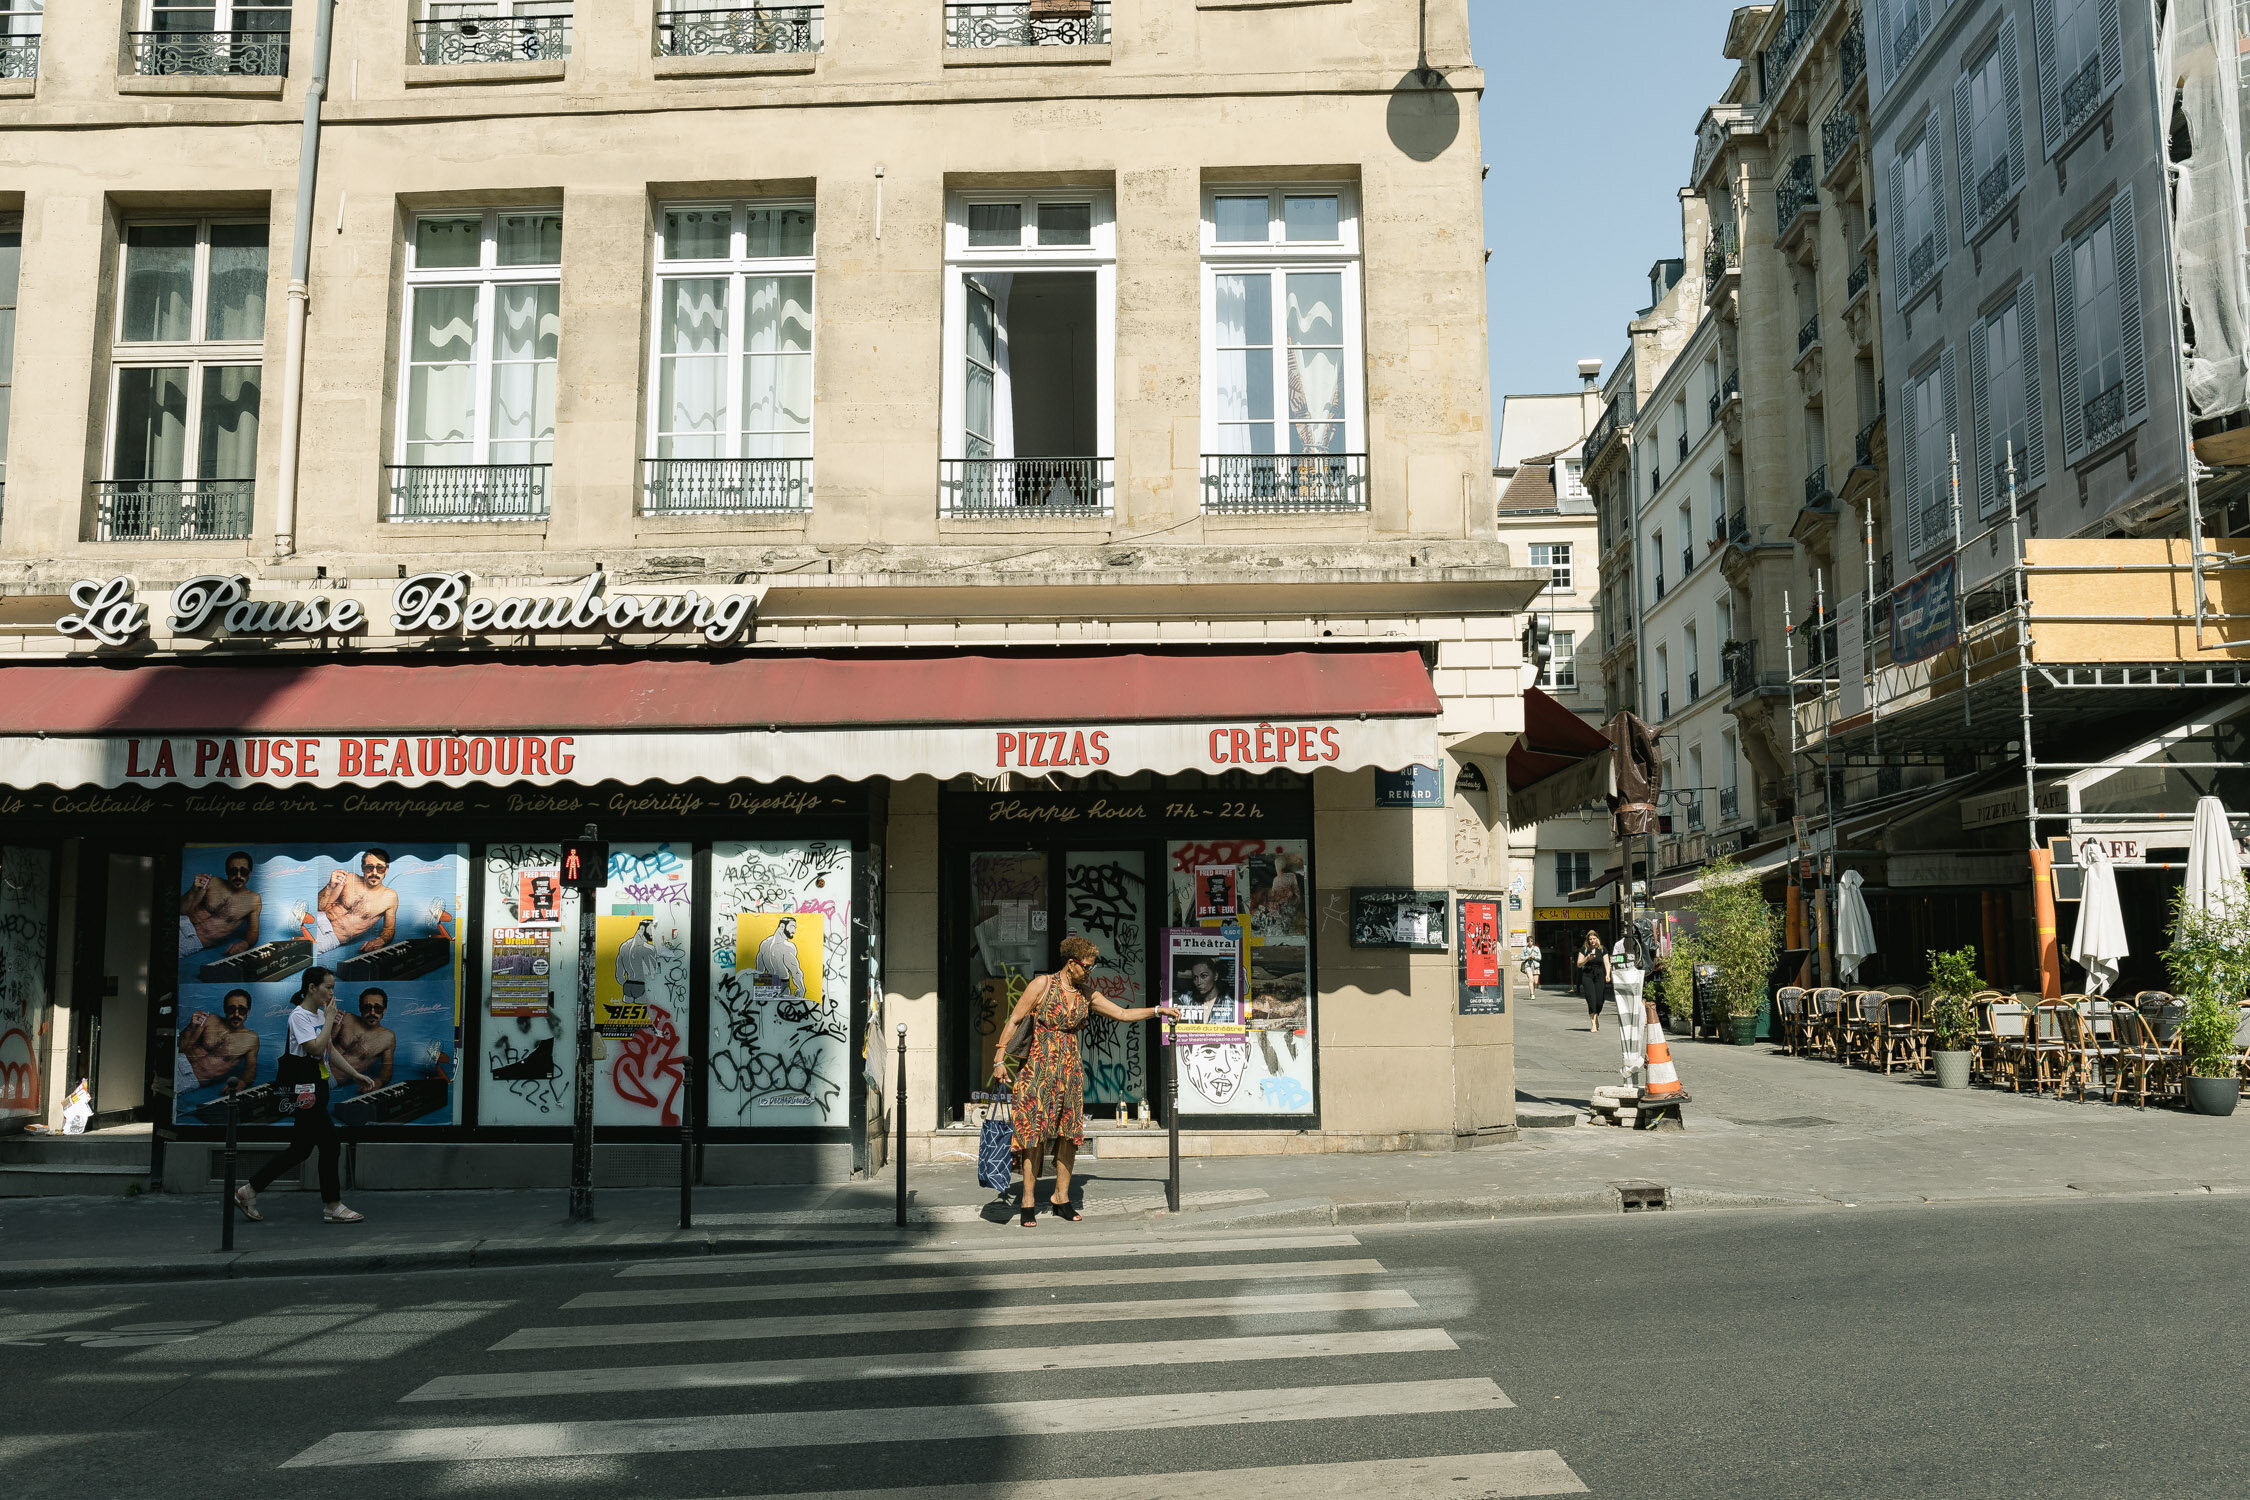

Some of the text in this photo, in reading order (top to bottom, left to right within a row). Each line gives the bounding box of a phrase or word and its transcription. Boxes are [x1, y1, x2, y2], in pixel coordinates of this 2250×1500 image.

[55, 571, 758, 646] La Pause Beaubourg
[996, 730, 1109, 768] PIZZAS
[1208, 722, 1340, 765] CRÊPES
[125, 737, 576, 778] LA PAUSE BEAUBOURG
[1400, 767, 1419, 776] RUE
[1388, 790, 1432, 799] RENARD
[51, 792, 821, 817] Cocktails Tulipe de vin Champagne Bières Apéritifs Digestifs
[989, 800, 1080, 822] Happy
[1088, 799, 1147, 818] hour
[1977, 801, 2018, 822] PIZZERIA
[522, 909, 530, 918] JE
[531, 909, 540, 918] TE
[1200, 906, 1207, 914] JE
[1207, 906, 1216, 914] TE
[494, 928, 549, 939] GOSPEL
[505, 937, 535, 945] Dream
[1183, 938, 1237, 948] Théâtral
[1180, 1009, 1204, 1020] ÉART
[971, 1091, 1013, 1100] GOSPE
